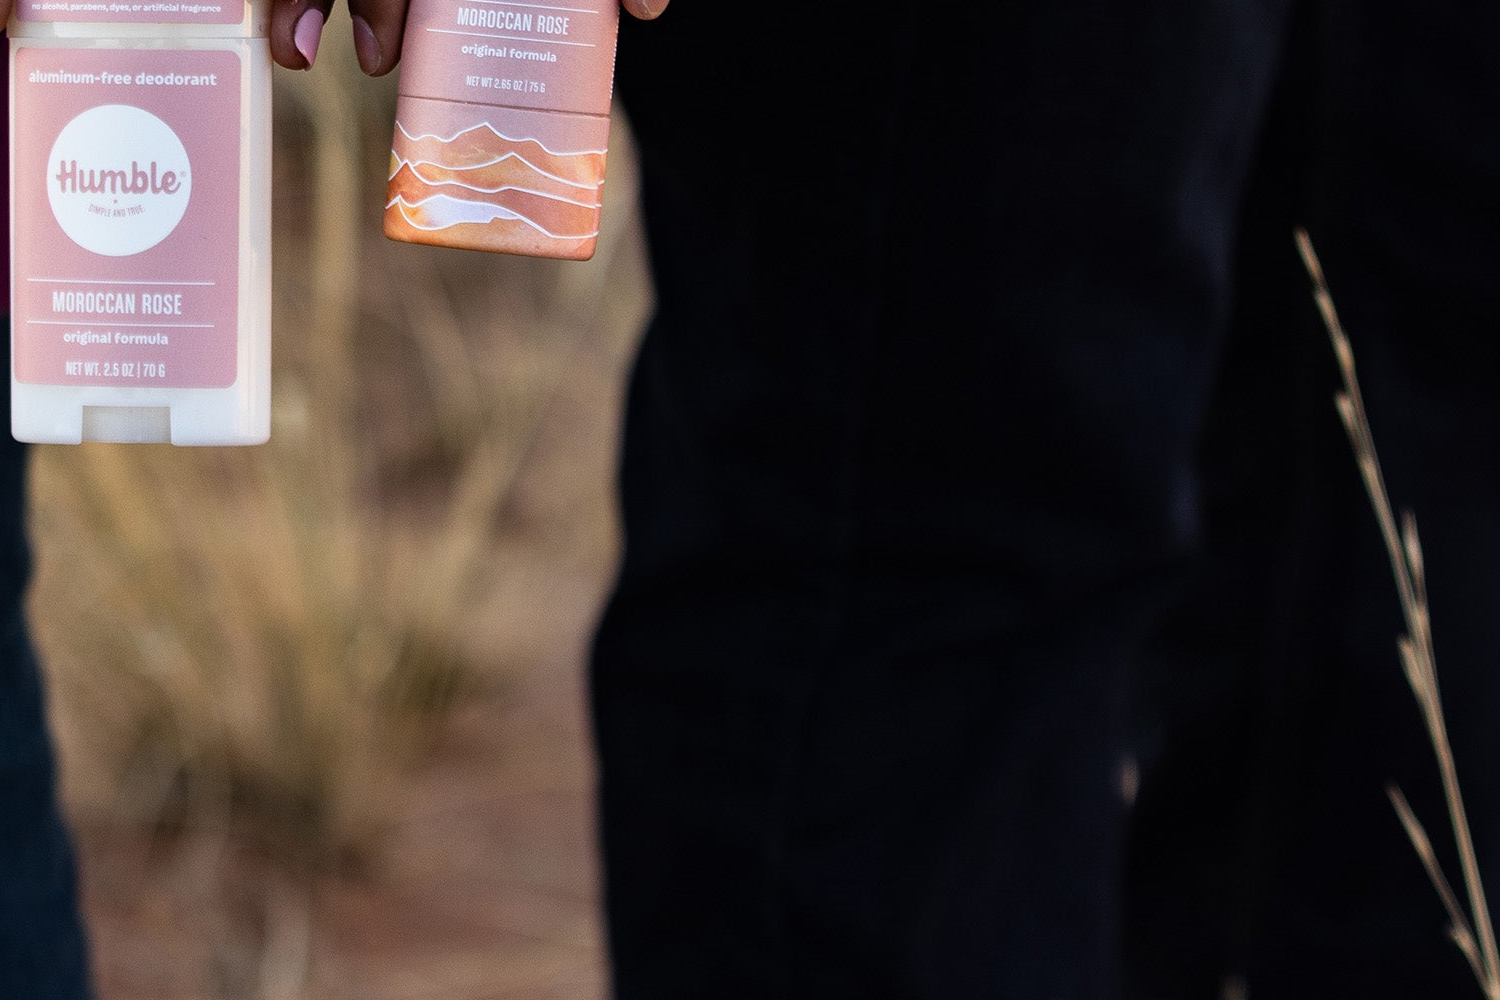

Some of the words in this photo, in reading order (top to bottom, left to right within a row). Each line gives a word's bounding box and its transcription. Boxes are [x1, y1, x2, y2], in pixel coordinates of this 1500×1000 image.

[41, 2, 70, 11] alcohol,
[70, 3, 108, 12] parabens,
[109, 3, 132, 13] dyes,
[132, 4, 143, 12] or
[143, 3, 180, 12] artificial
[181, 4, 222, 14] fragrance
[457, 7, 532, 32] MOROCCAN
[536, 15, 570, 36] ROSE
[461, 43, 507, 58] original
[509, 49, 558, 63] formula
[29, 70, 132, 85] aluminum-free
[135, 72, 218, 86] deodorant
[466, 75, 480, 87] NET
[494, 78, 512, 90] 2.65
[513, 80, 523, 92] OZ
[529, 82, 539, 93] 75
[56, 160, 182, 195] Humble
[88, 204, 111, 218] SIMPLE
[112, 209, 126, 218] AND
[52, 291, 136, 315] MOROCCAN
[141, 294, 182, 316] ROSE
[63, 331, 111, 346] original
[114, 332, 169, 346] formula
[66, 361, 83, 376] NET
[84, 362, 101, 377] WT.
[103, 362, 119, 377] 2.5
[121, 363, 134, 377] OZ
[143, 363, 156, 378] 70
[158, 363, 166, 378] G
